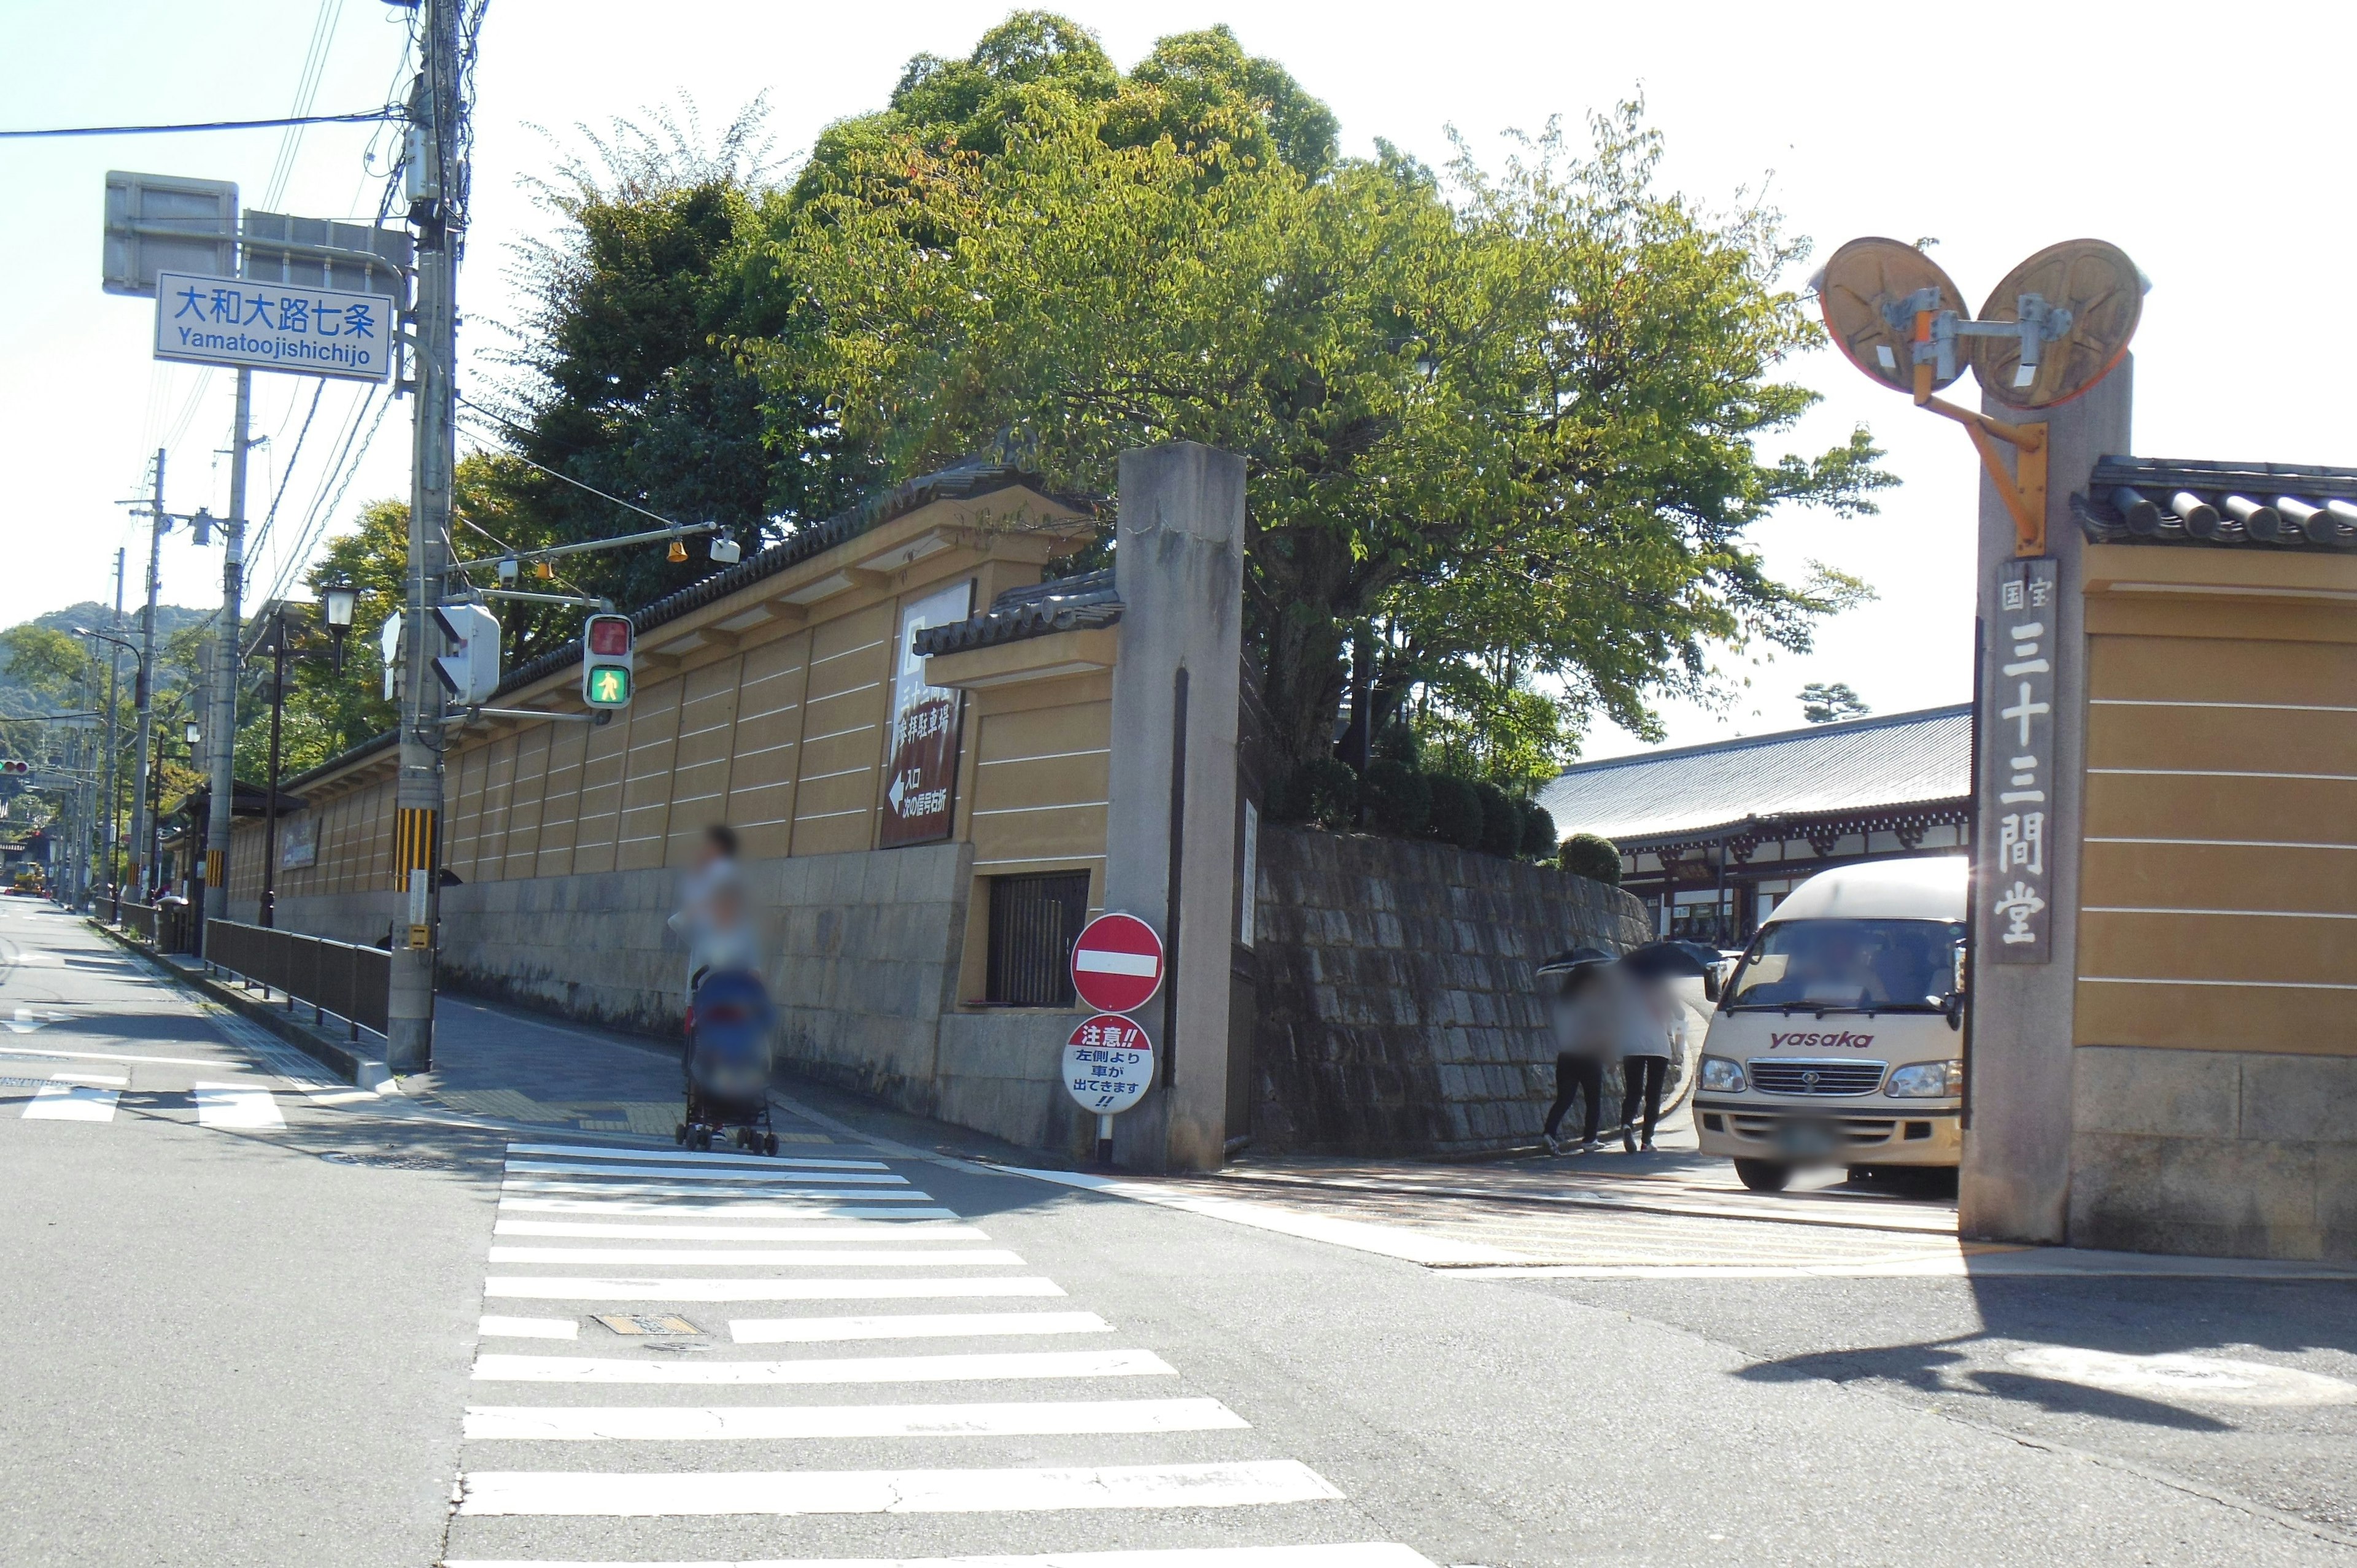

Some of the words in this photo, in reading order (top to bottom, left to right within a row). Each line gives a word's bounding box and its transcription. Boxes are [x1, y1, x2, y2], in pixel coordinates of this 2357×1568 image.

[175, 286, 374, 338] 大和大路七条
[179, 326, 370, 366] Yamatoojishichijo
[2002, 578, 2053, 610] 国宝
[905, 768, 920, 789] 入口
[1994, 621, 2051, 944] 三十三間堂
[903, 790, 946, 818] 次の信号右折
[1770, 1031, 1875, 1049] yasaka
[1076, 1049, 1140, 1064] 左側より
[1091, 1065, 1124, 1078] 車が
[1073, 1079, 1139, 1094] 出てきます
